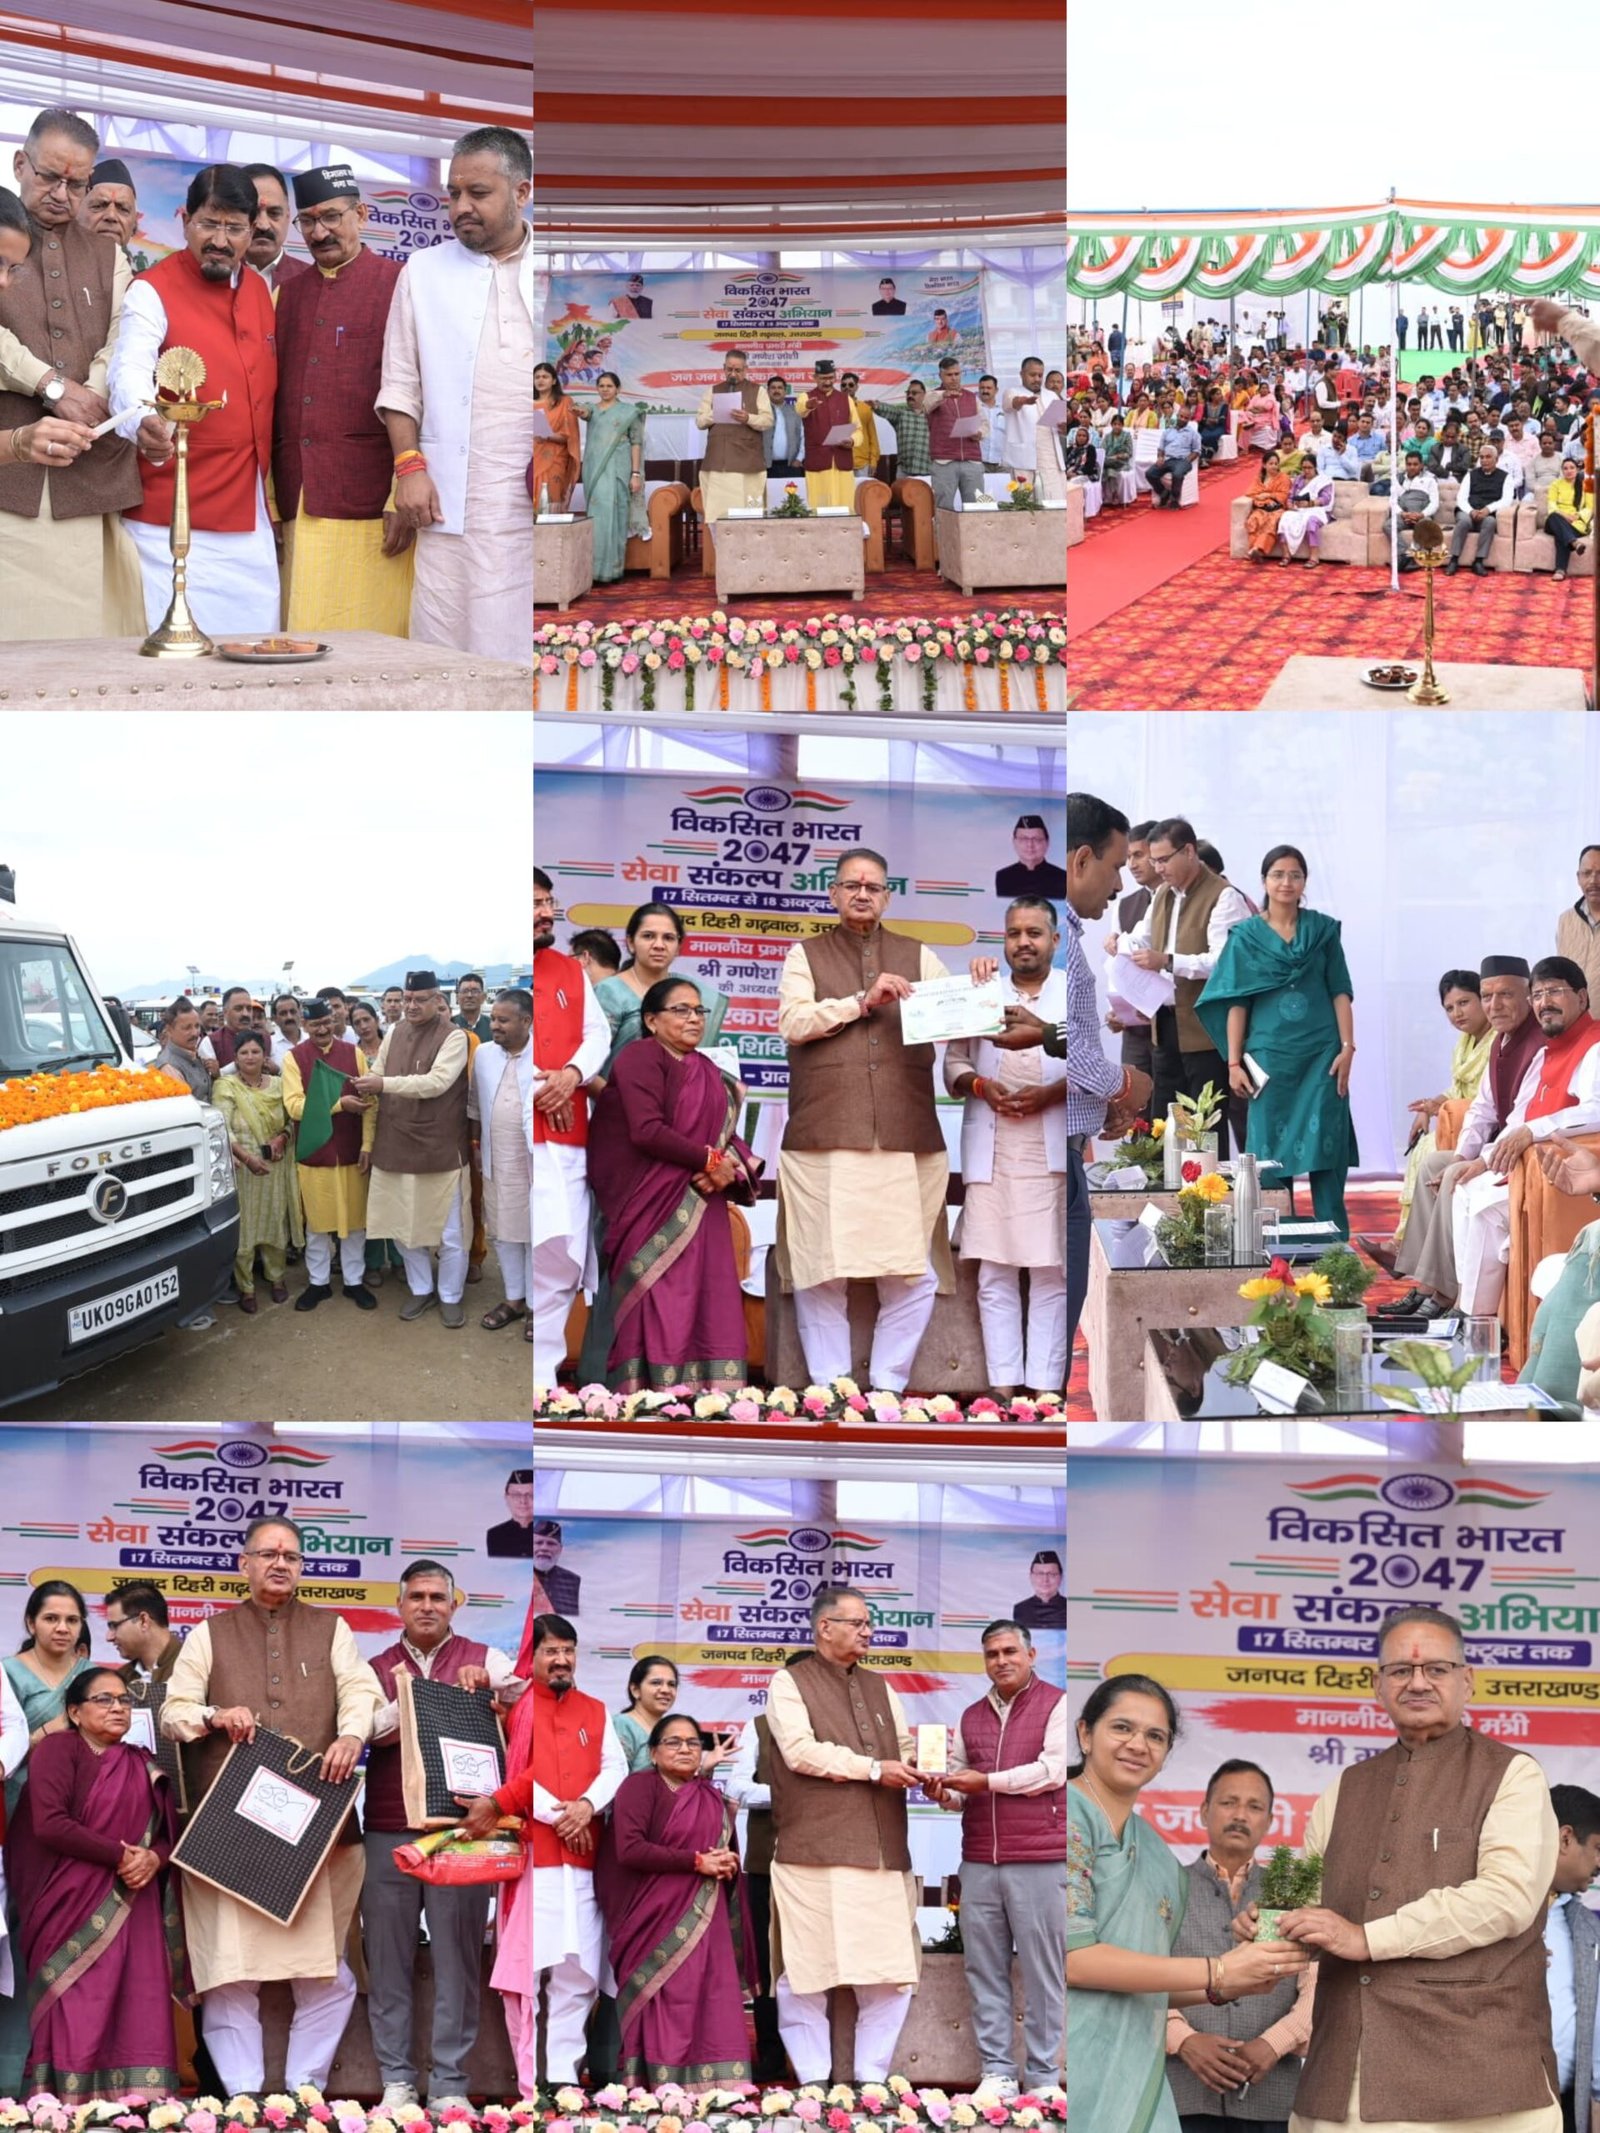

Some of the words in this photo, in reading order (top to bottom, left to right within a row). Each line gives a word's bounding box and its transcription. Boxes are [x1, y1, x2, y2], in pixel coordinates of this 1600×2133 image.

[724, 284, 776, 297] विकसित
[778, 286, 811, 297] भारत
[748, 296, 788, 308] 2047
[703, 307, 730, 319] सेवा
[732, 307, 776, 319] संकल्प
[779, 307, 833, 319] अभियान
[669, 807, 786, 839] विकसित
[792, 820, 863, 842] भारत
[723, 839, 811, 866] 2047
[621, 856, 680, 883] सेवा
[687, 860, 783, 889] संकल्प
[662, 890, 676, 901] 17
[681, 889, 740, 905] सितम्बर
[743, 892, 757, 906] से
[762, 896, 778, 907] 18
[701, 911, 742, 930] टिहरी
[689, 938, 753, 956] माननीय
[697, 960, 722, 978] श्री
[725, 961, 778, 981] गणेश
[718, 981, 734, 993] की
[47, 1141, 152, 1178] FORCE
[81, 1274, 178, 1331] UK09GA0152
[138, 1463, 262, 1495] विकसित
[267, 1478, 344, 1500] भारत
[86, 1514, 149, 1545] सेवा
[157, 1520, 247, 1548] संकल्
[300, 1526, 394, 1556] भियान
[1266, 1506, 1445, 1549] विकसित
[1455, 1525, 1566, 1555] भारत
[129, 1553, 145, 1564] 17
[150, 1552, 213, 1568] सितम्बर
[216, 1553, 233, 1568] से
[317, 1562, 350, 1576] तक
[723, 1549, 826, 1577] विकसित
[831, 1560, 895, 1580] भारत
[1348, 1552, 1485, 1593] 2047
[173, 1575, 214, 1593] टिहरी
[680, 1597, 733, 1622] सेवा
[738, 1599, 813, 1624] संकल्
[1189, 1579, 1281, 1620] सेवा
[716, 1630, 729, 1639] 17
[733, 1627, 785, 1641] सितम्बर
[788, 1628, 802, 1641] से
[873, 1634, 900, 1645] तक
[1252, 1632, 1276, 1647] 17
[1282, 1628, 1375, 1653] सितम्बर
[1529, 1644, 1575, 1662] तक
[701, 1649, 747, 1663] जनपद
[751, 1648, 786, 1663] टिहरी
[1224, 1666, 1307, 1689] जनपद
[1314, 1665, 1375, 1690] टिहरी
[747, 1689, 768, 1706] श्री
[1295, 1704, 1395, 1731] माननीय
[1478, 1707, 1530, 1737] मंत्री
[1307, 1737, 1346, 1767] श्री
